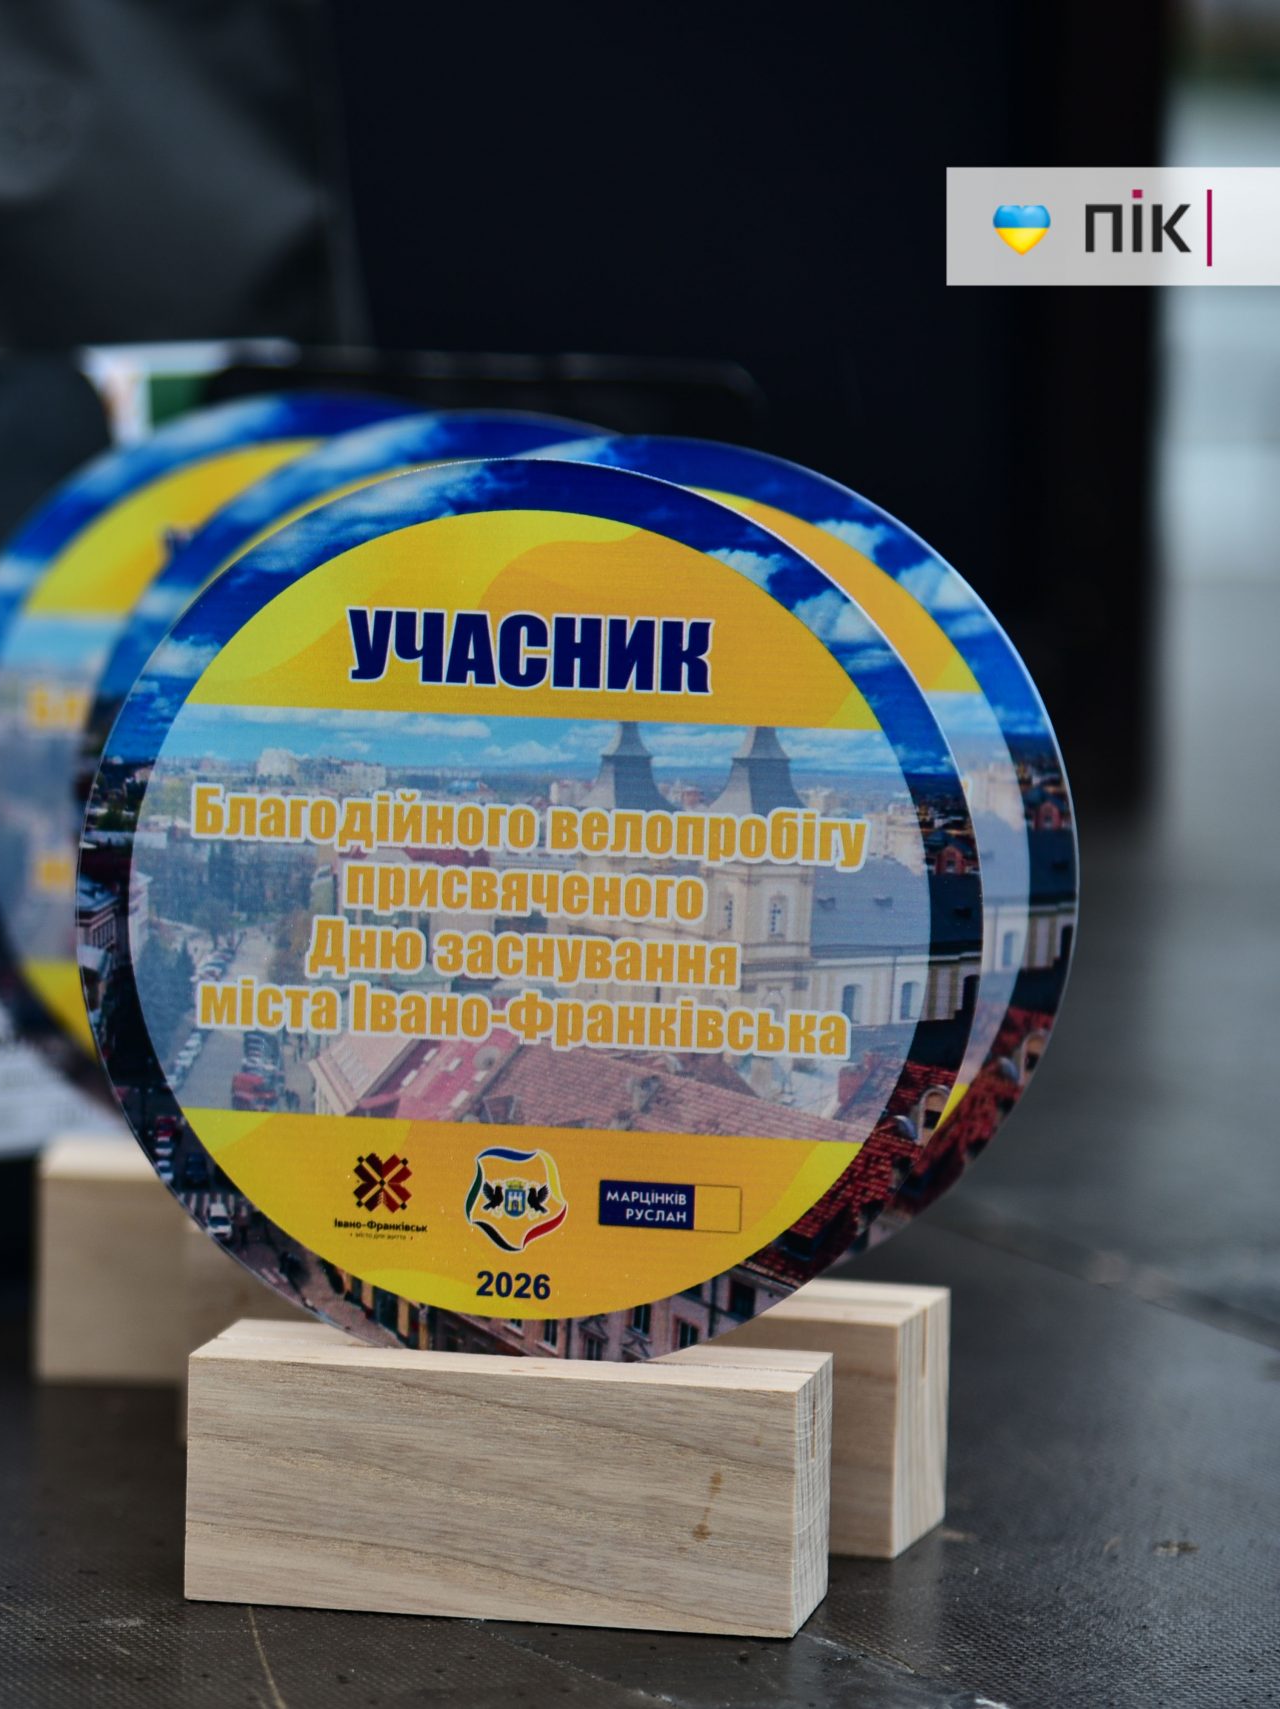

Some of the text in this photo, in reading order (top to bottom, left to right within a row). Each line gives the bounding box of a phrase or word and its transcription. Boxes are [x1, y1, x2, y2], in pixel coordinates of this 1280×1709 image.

[347, 605, 715, 695] УЧАСНИК
[191, 783, 869, 873] Благодійного велопробігу
[345, 860, 706, 926] присвяченого
[306, 916, 741, 991] Дню заснування
[197, 978, 851, 1058] міста Івано-Франківська
[334, 1218, 428, 1232] Івано-Франківськ
[606, 1189, 687, 1206] МАРЦІНКІВ
[626, 1208, 687, 1223] РУСЛАН
[476, 1270, 551, 1300] 2026
